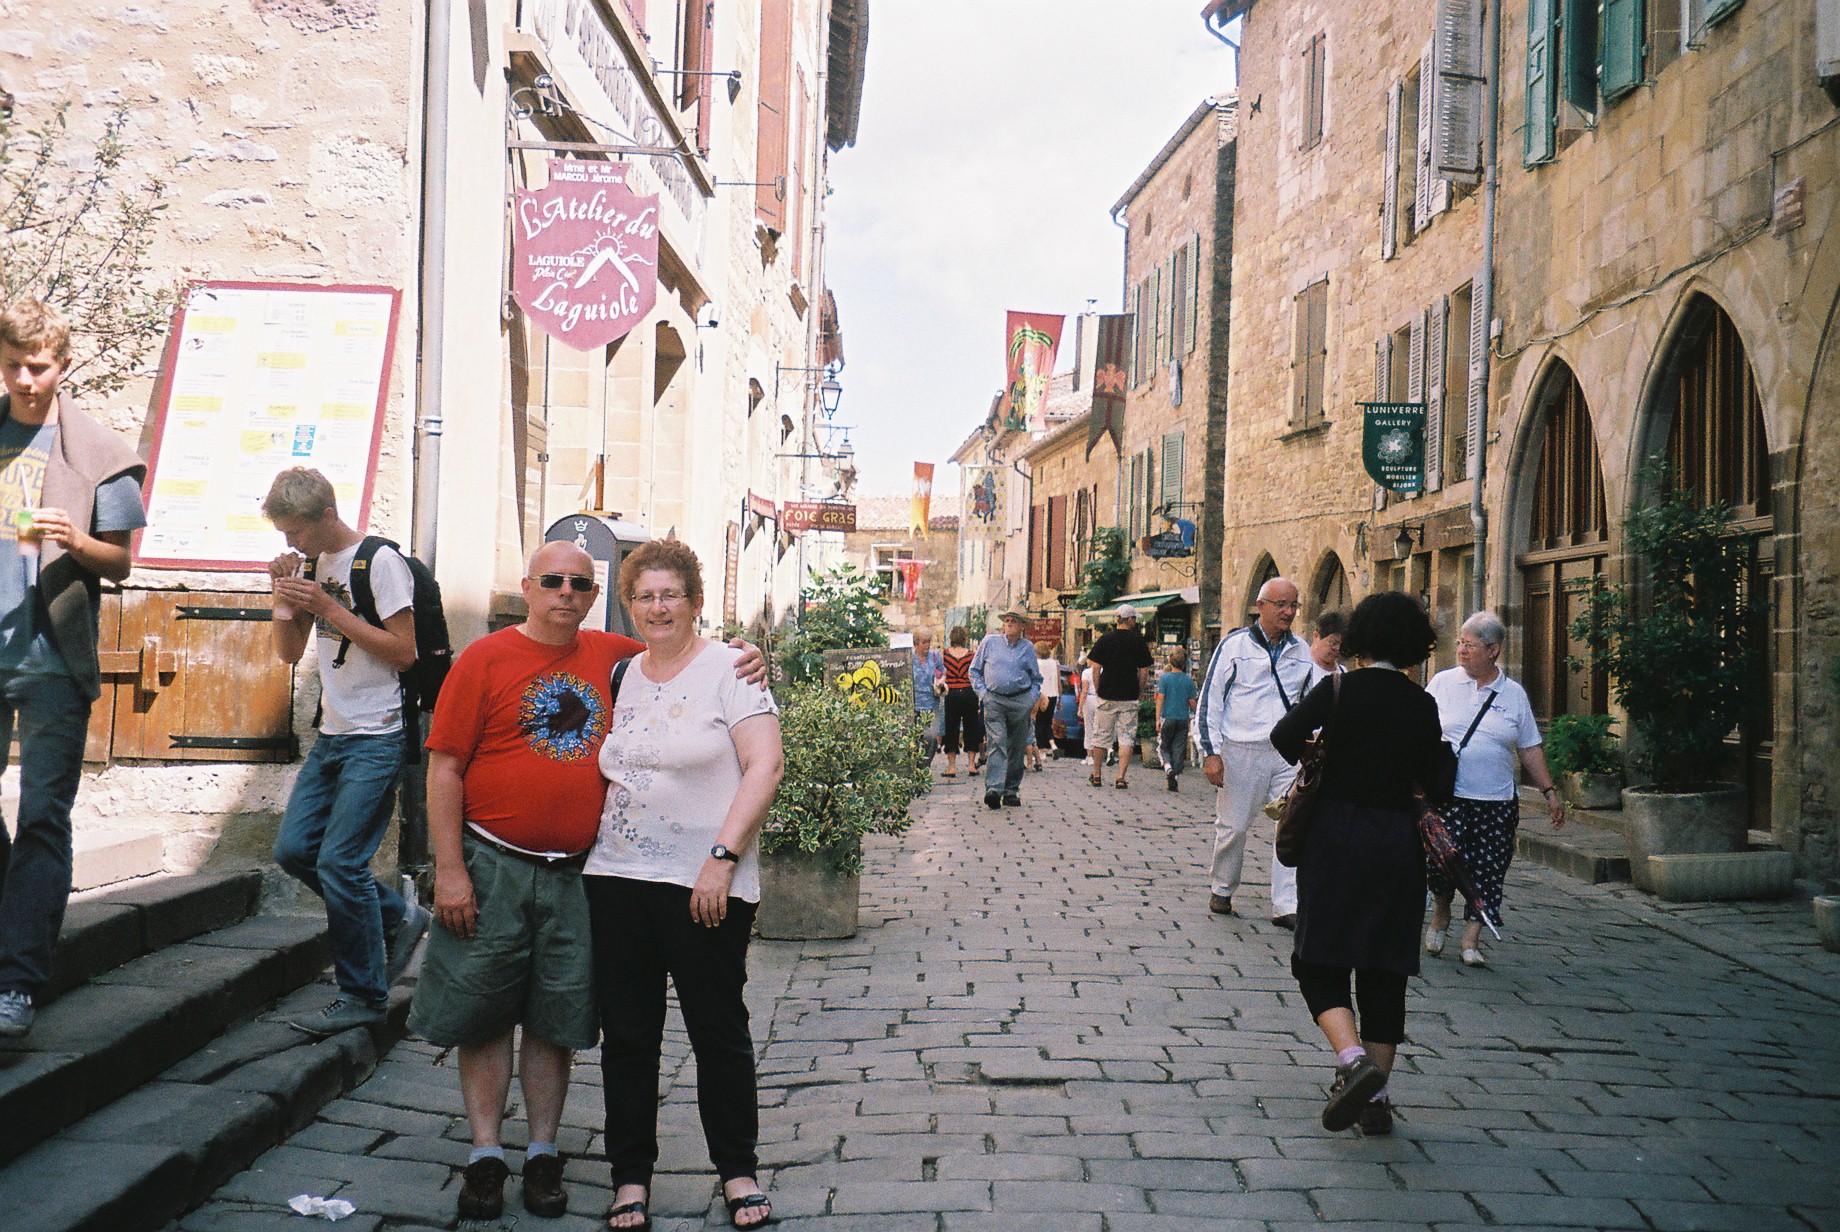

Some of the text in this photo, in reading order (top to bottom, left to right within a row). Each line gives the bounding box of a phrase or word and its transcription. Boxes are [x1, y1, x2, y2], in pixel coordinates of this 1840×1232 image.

[563, 163, 613, 174] Mme et Mr
[553, 171, 588, 182] MARCOU
[520, 189, 656, 240] L'Atelier du
[528, 254, 585, 268] LAGUIOLE
[531, 281, 639, 332] Laguiole
[1366, 406, 1424, 414] LUNIVERRE
[784, 509, 817, 523] FOIE
